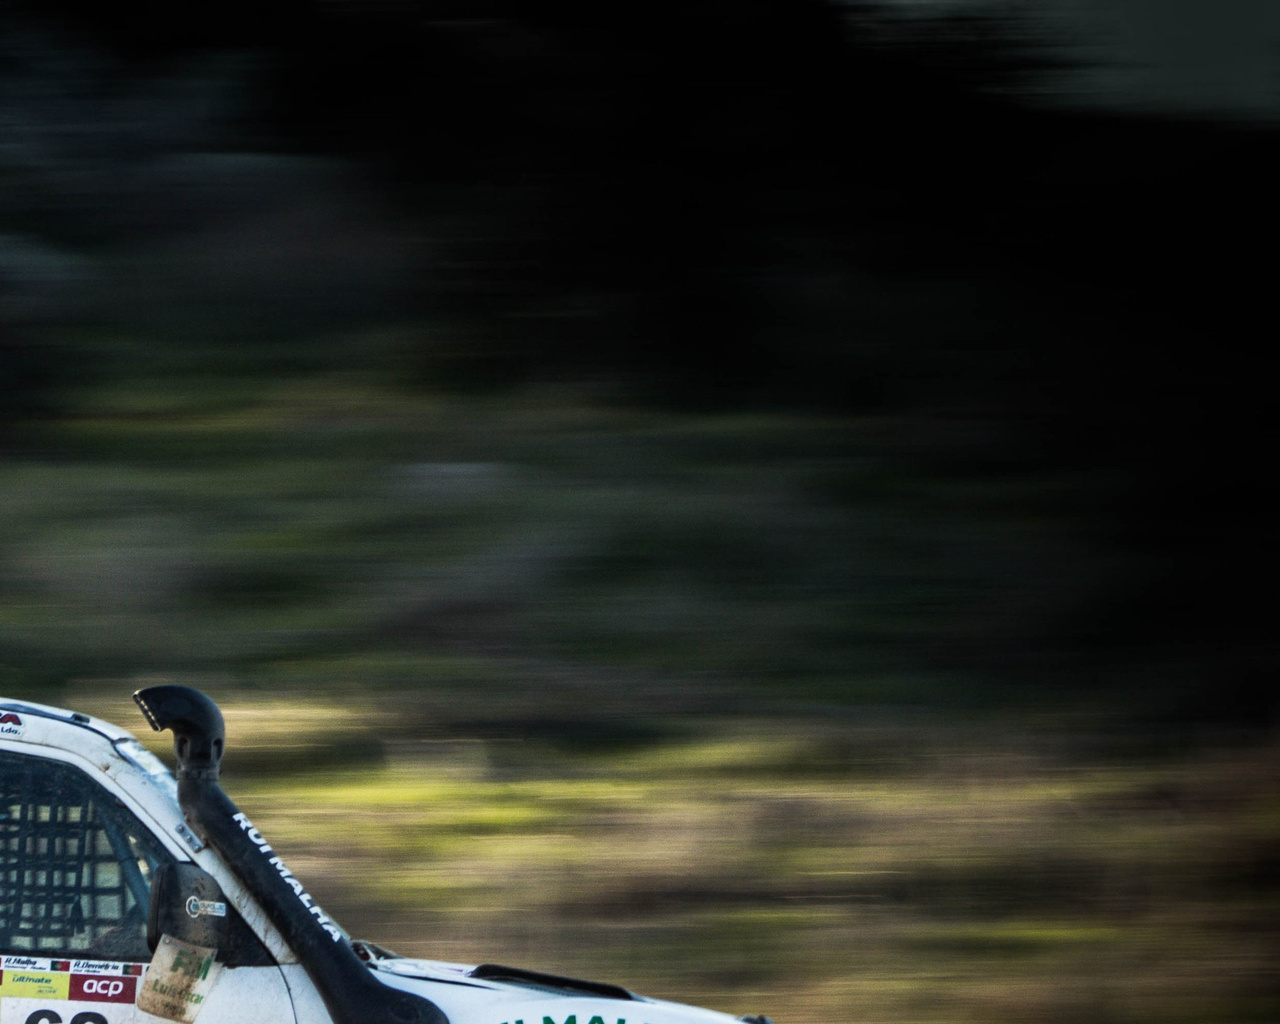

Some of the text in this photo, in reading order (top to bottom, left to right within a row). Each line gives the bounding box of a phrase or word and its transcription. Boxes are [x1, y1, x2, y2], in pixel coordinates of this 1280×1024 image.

[232, 812, 342, 943] RUI MALHA
[83, 979, 124, 997] acp
